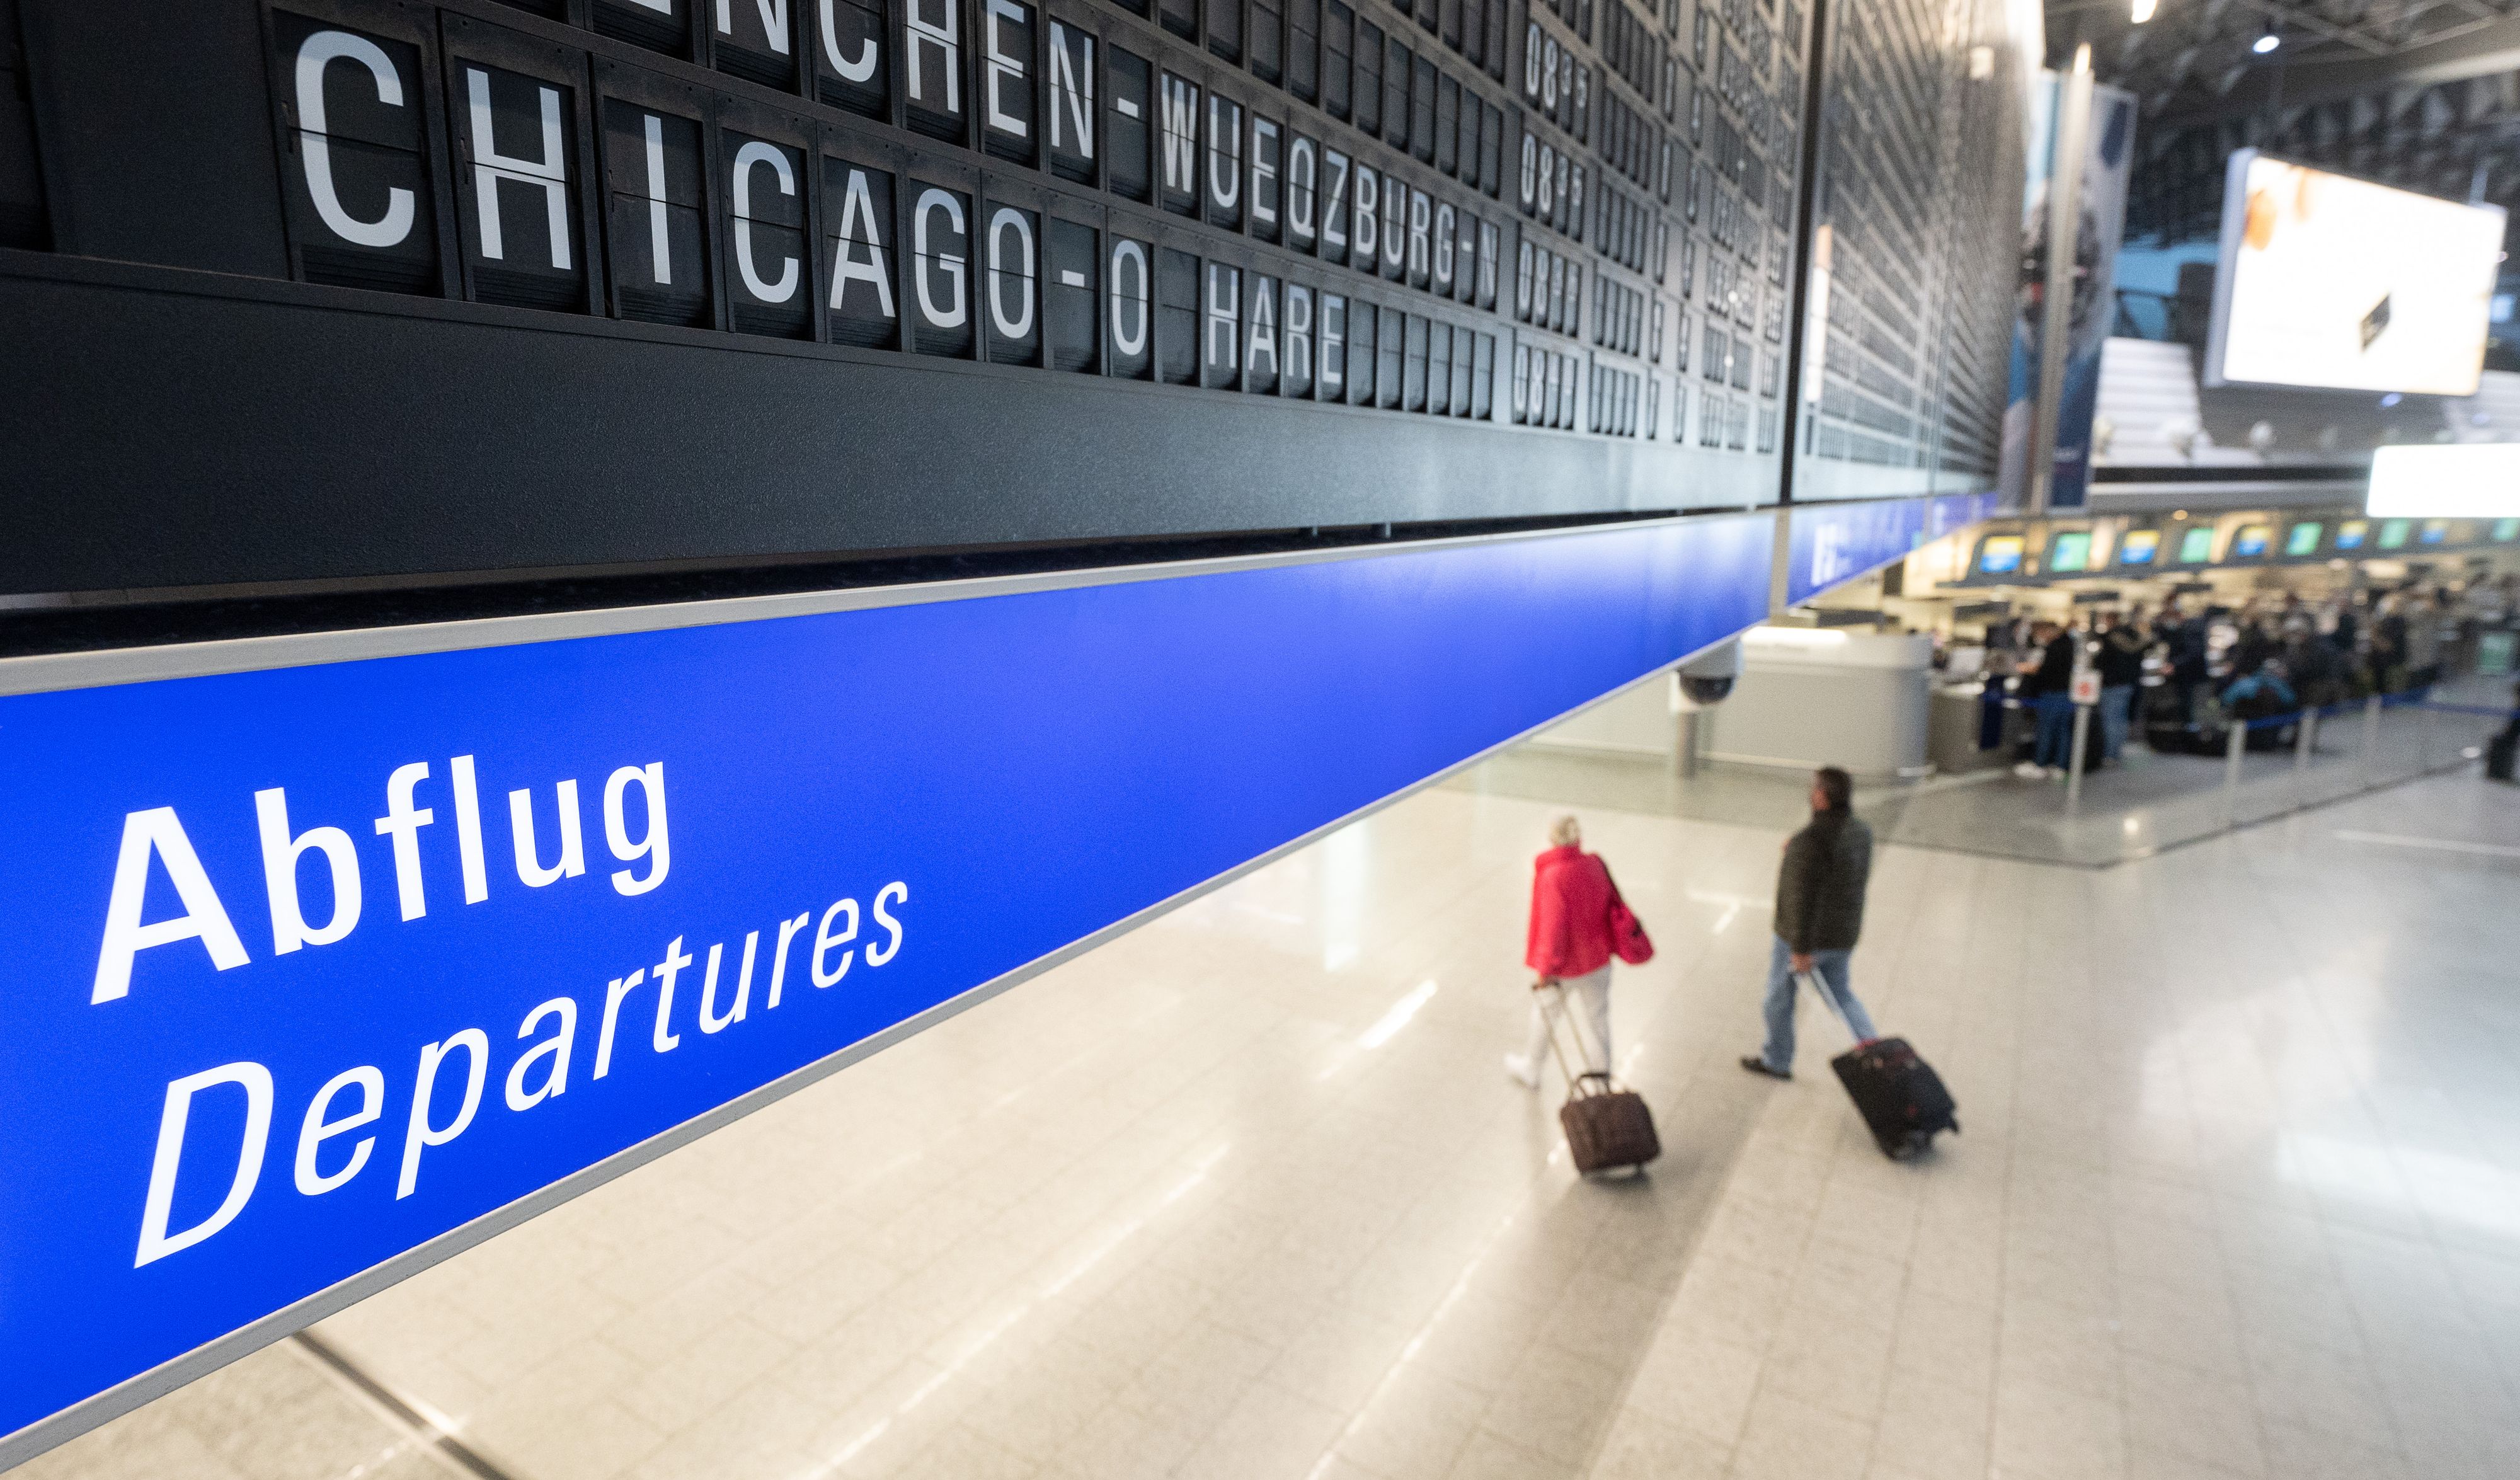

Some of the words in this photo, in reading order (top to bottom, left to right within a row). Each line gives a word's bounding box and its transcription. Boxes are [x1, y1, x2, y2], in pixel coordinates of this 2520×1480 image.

[295, 30, 1148, 355] CHICAGO-O
[1208, 262, 1344, 384] HARE
[90, 754, 672, 1005] Abflug
[134, 881, 908, 1268] Departures
